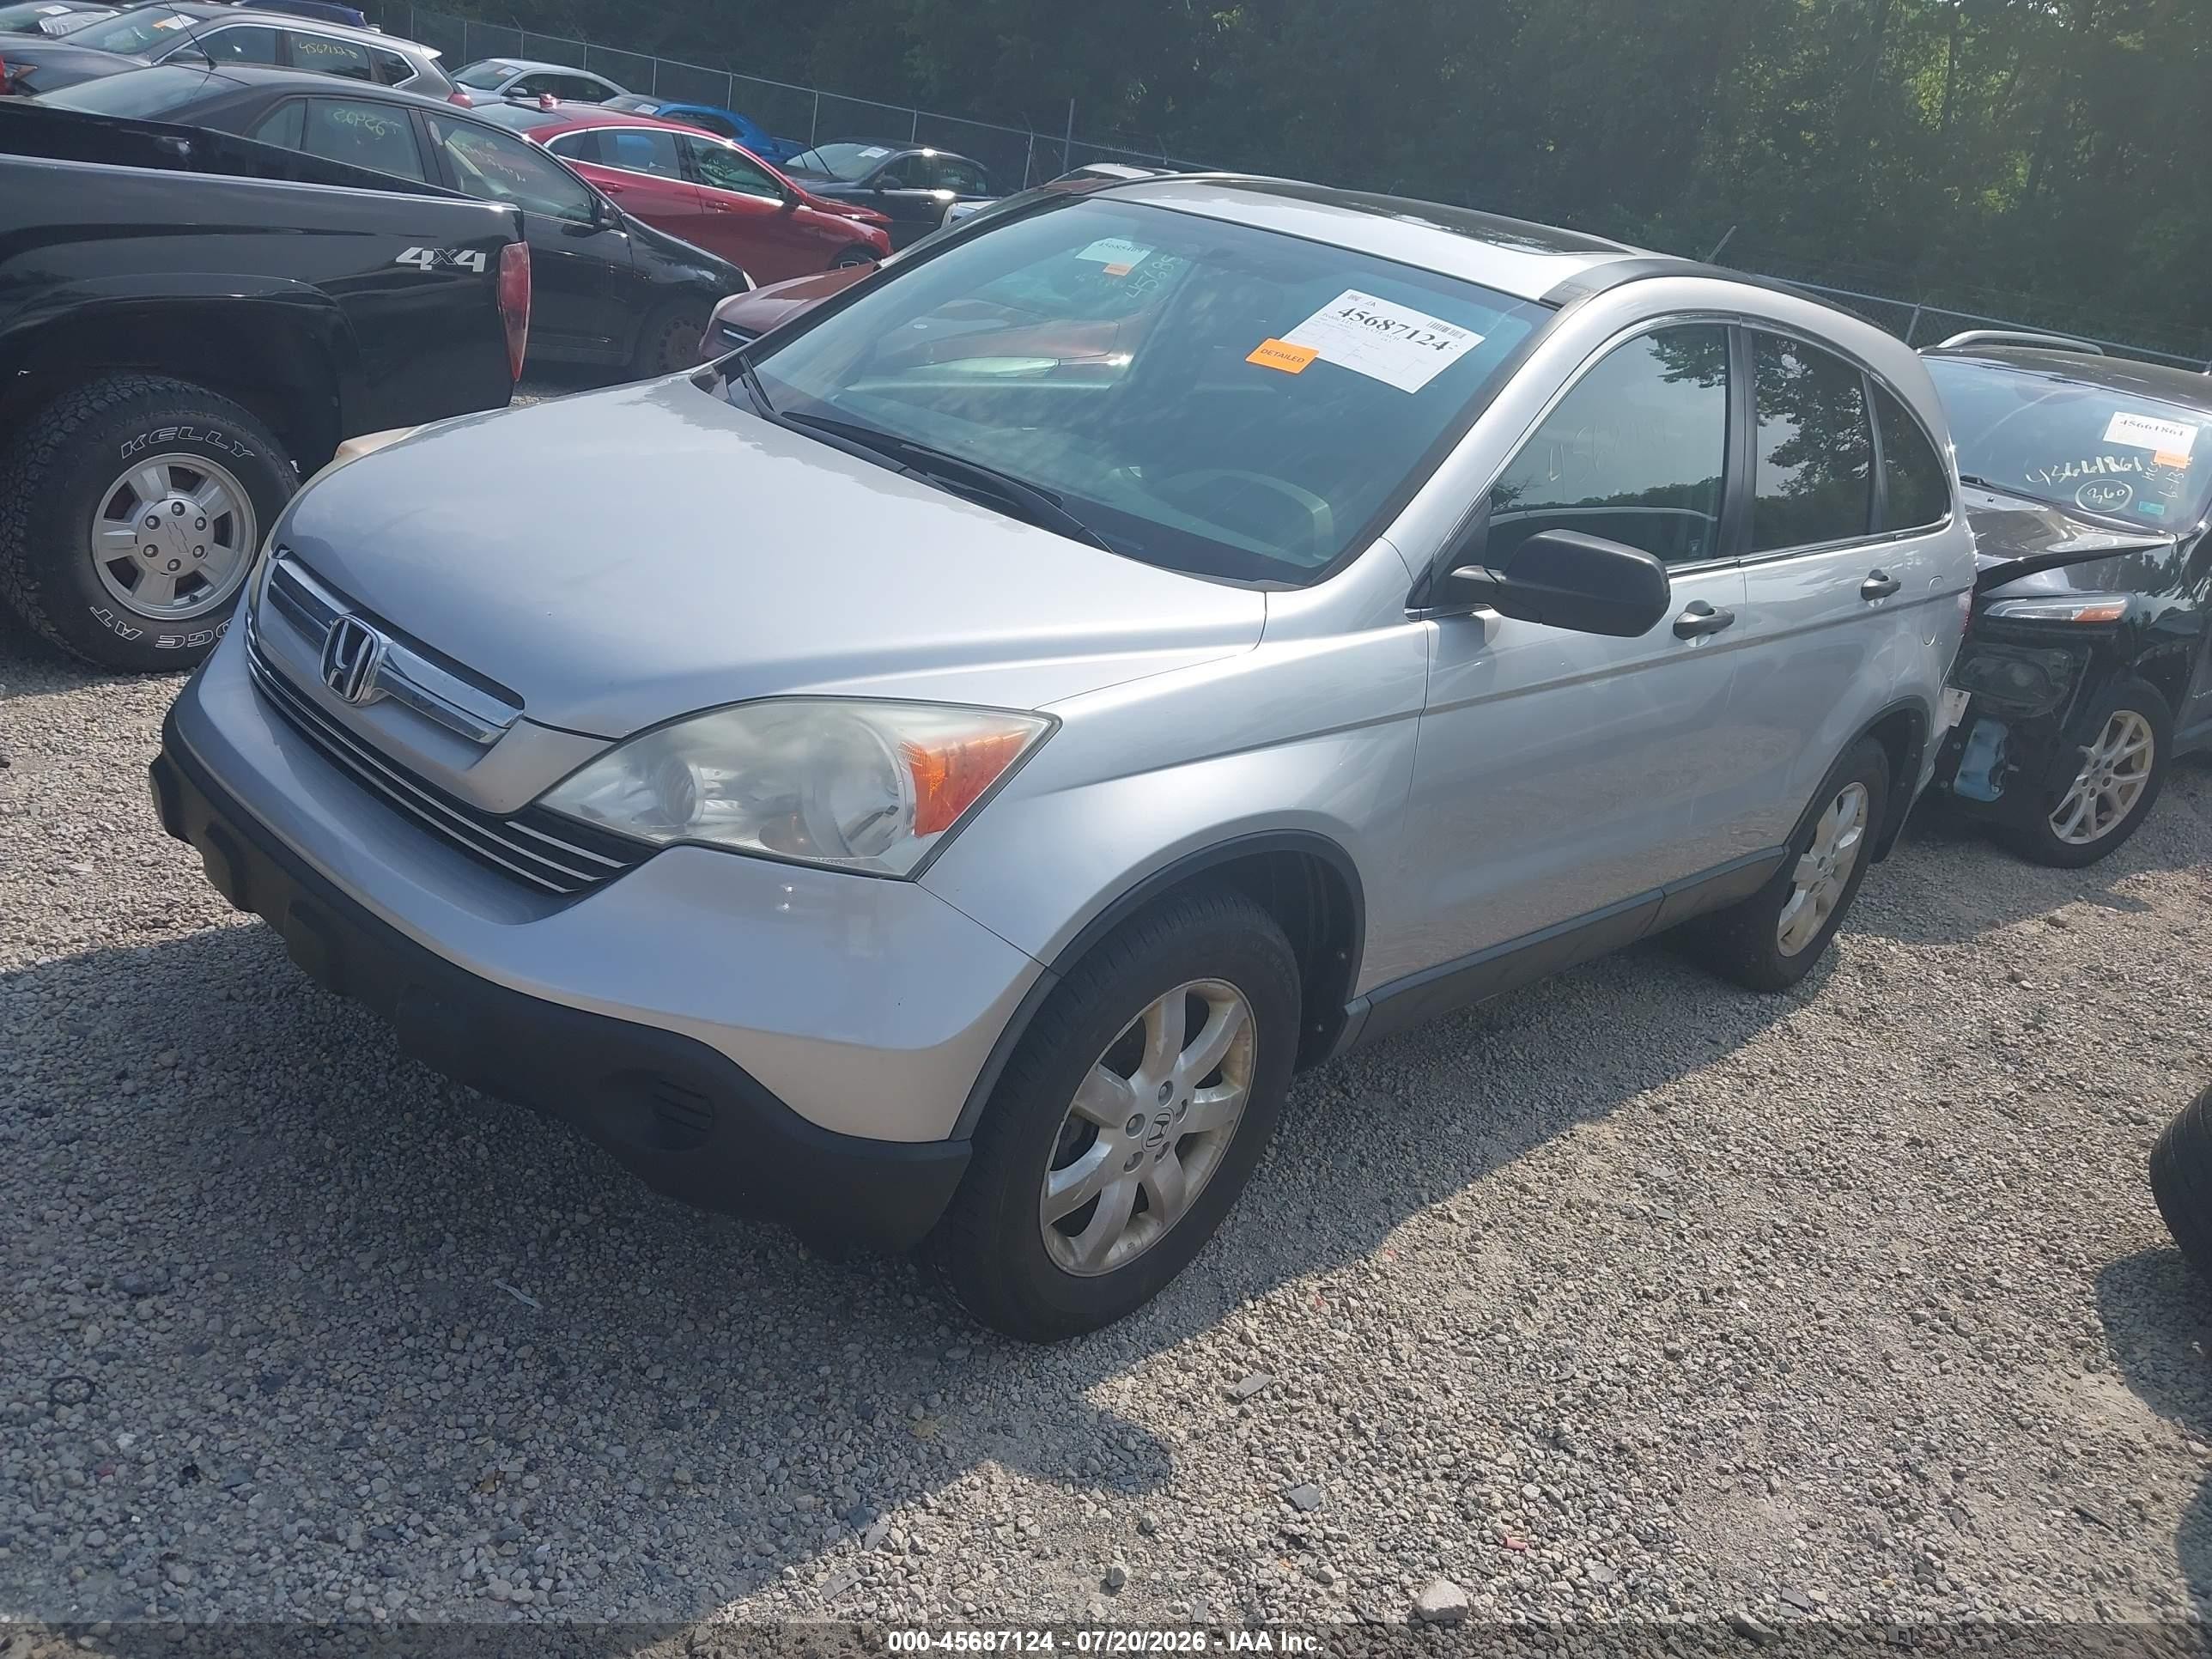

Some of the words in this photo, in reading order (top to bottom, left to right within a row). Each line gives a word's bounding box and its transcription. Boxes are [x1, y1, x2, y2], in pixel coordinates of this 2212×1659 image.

[1338, 307, 1450, 350] 45687124
[1261, 348, 1305, 363] DETAILED
[121, 426, 255, 459] KELLY
[2087, 487, 2125, 504] 360
[89, 606, 143, 641] AT
